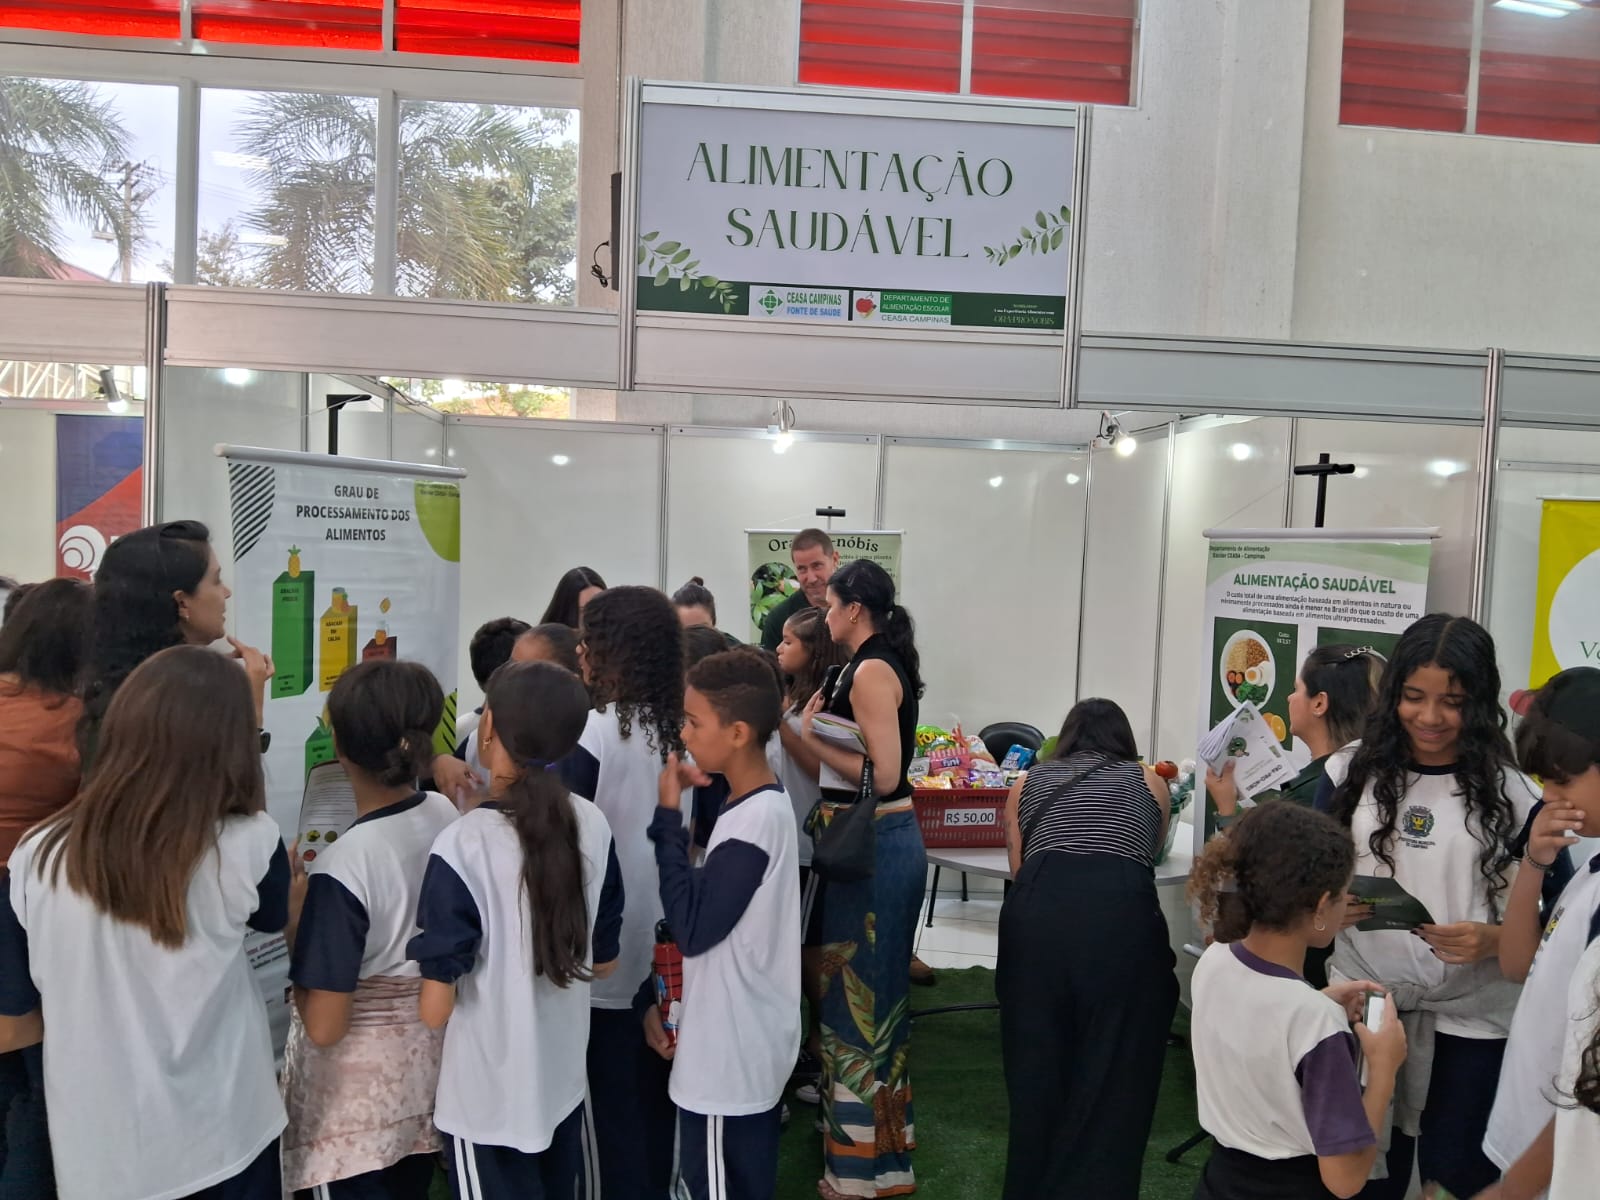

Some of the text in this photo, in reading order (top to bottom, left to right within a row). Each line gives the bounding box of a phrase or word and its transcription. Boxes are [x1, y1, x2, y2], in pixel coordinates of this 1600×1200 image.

[686, 142, 1013, 202] ALIMENTAÇÃO
[725, 207, 969, 259] SAUDÁVEL
[786, 292, 842, 306] CEASA CAMPINAS
[883, 294, 939, 303] DEPARTAMENTO
[786, 306, 808, 315] FONTE
[809, 307, 818, 315] DE
[882, 303, 921, 312] ALIMENTAÇÃO
[881, 314, 950, 324] CEASA CAMPINAS
[334, 484, 379, 499] GRAU DE
[296, 505, 410, 522] PROCESSAMENTO DOS
[325, 527, 386, 541] ALIMENTOS
[1233, 572, 1396, 594] ALIMENTAÇÃO SAUDÁVEL
[1252, 600, 1284, 609] processados
[1332, 605, 1348, 613] Brasil
[1275, 594, 1307, 603] alimentação
[1308, 595, 1331, 604] baseada
[1342, 598, 1372, 607] alimentos
[1242, 606, 1273, 616] alimentação
[1273, 609, 1294, 617] baseada
[1305, 611, 1332, 621] alimentos
[1333, 614, 1386, 625] ultraprocessados.
[1580, 641, 1600, 660] V
[942, 757, 960, 767] fini
[945, 812, 994, 824] R$ 50,00
